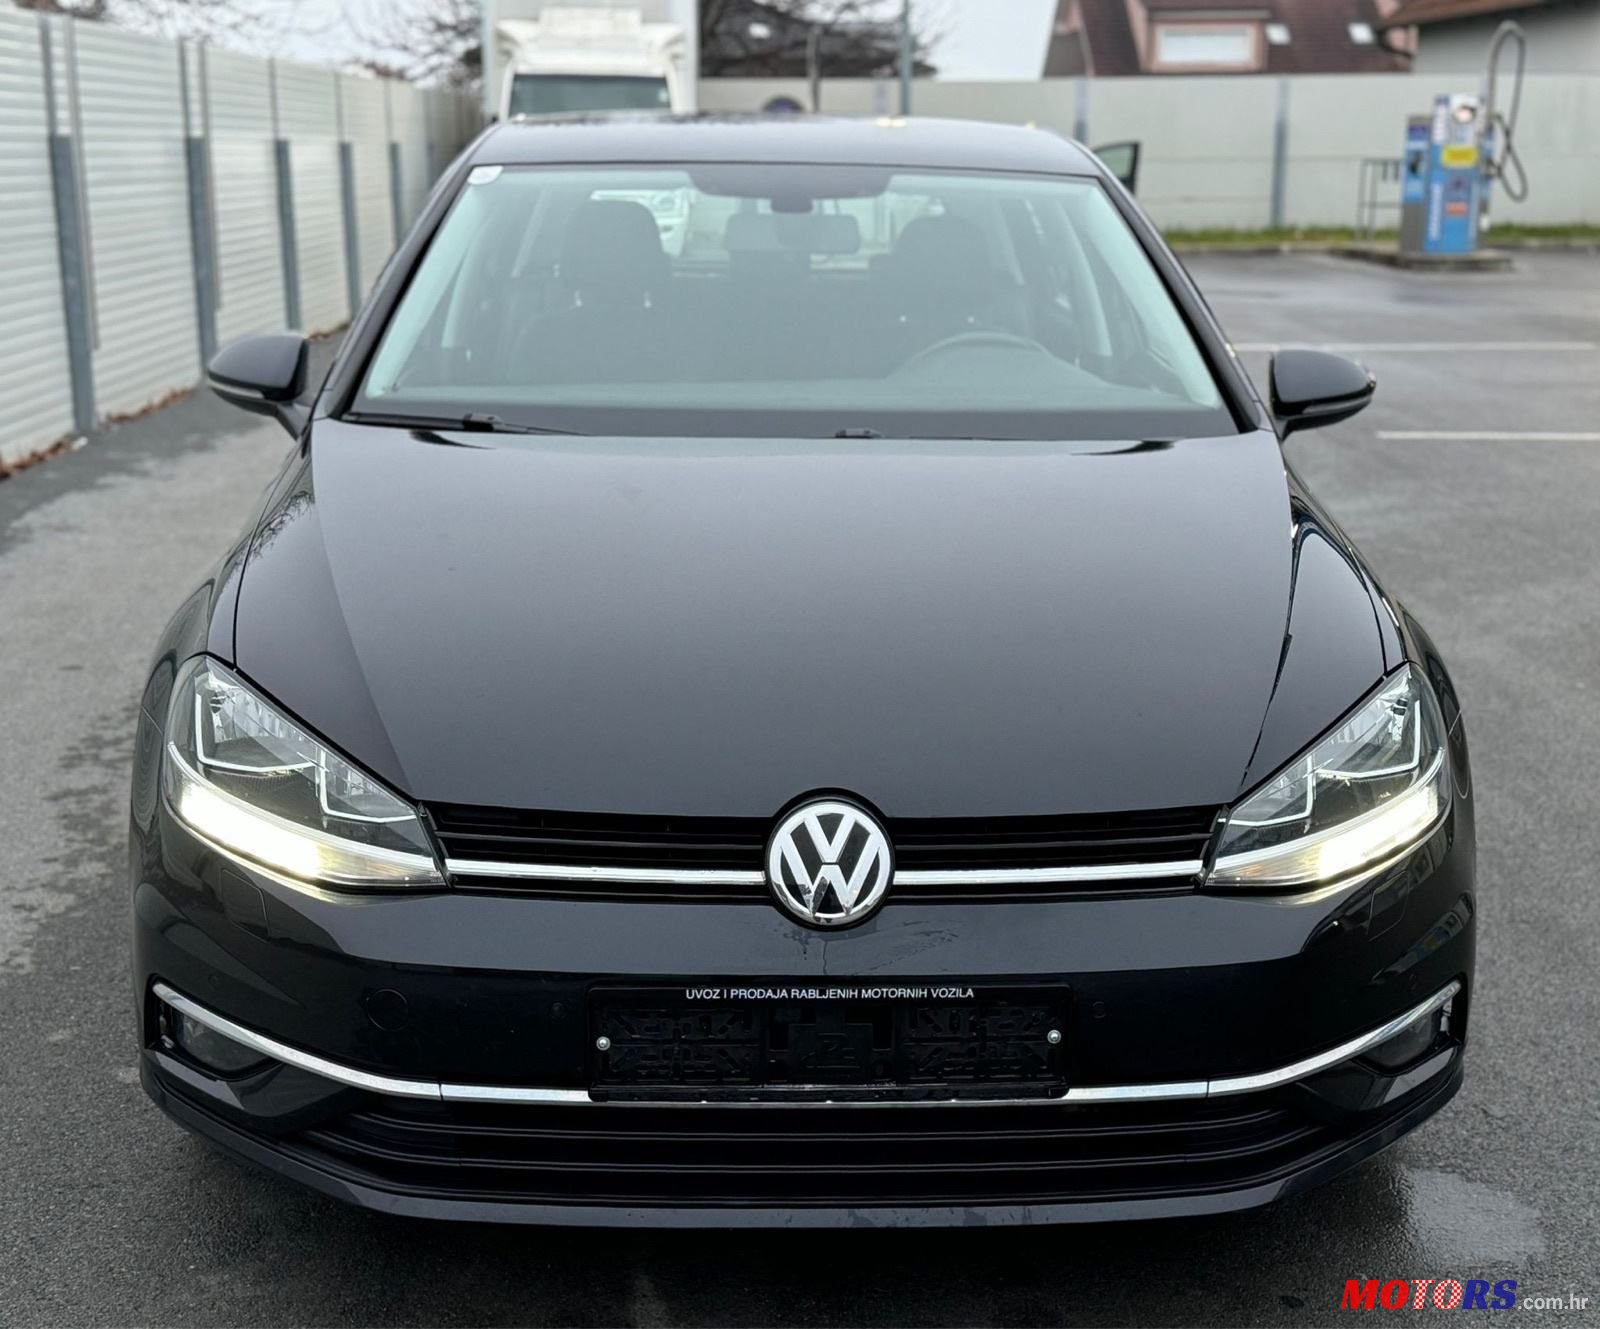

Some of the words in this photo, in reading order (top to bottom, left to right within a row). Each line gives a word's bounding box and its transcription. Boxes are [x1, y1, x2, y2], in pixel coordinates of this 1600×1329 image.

[773, 805, 889, 918] VW
[686, 989, 720, 999] UVOZ
[730, 989, 789, 999] PRODAJA
[791, 988, 858, 999] RABLJENIH
[861, 988, 927, 999] MOTORNIH
[930, 987, 974, 998] VOZILA
